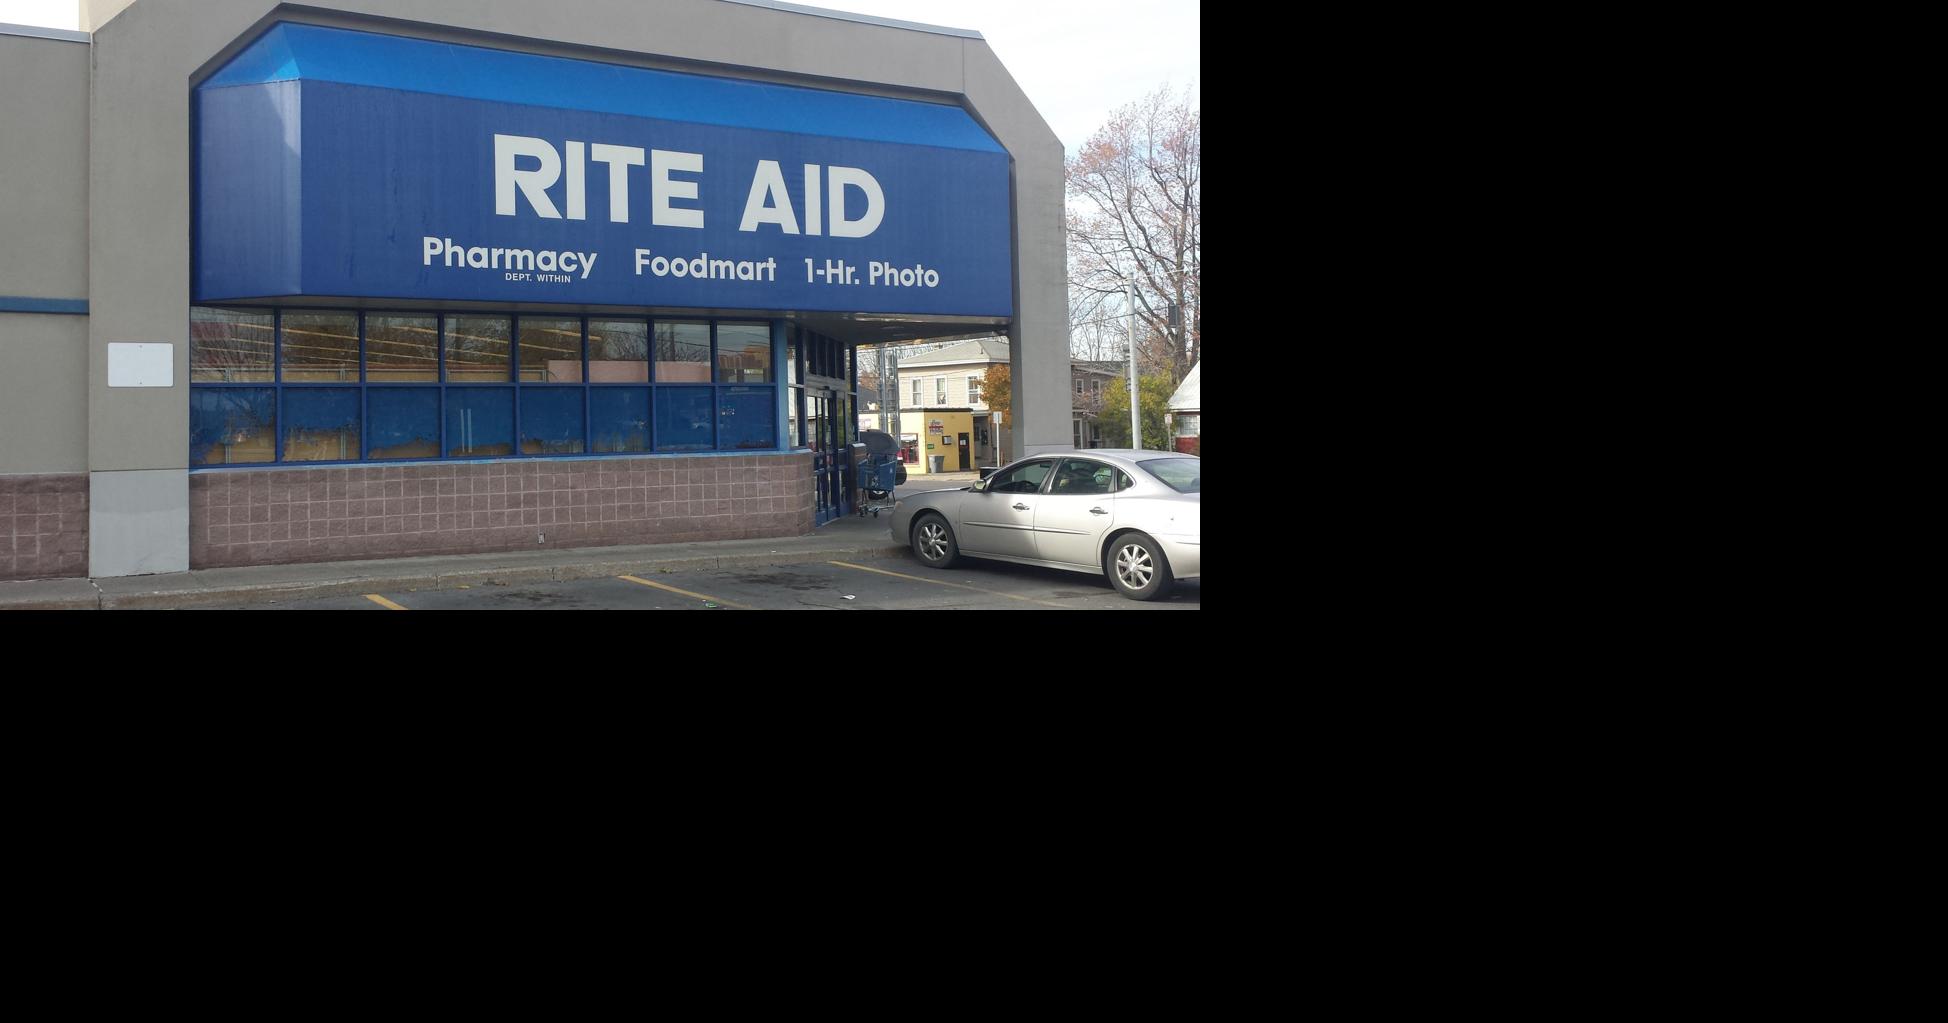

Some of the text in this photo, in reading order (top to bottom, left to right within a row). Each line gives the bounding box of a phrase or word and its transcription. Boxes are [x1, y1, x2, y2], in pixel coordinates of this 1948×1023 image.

[494, 133, 886, 238] RITE AID
[423, 236, 940, 288] Pharmacy Foodmart 1-Hr. Photo
[505, 272, 571, 283] DEPT. WITHIN
